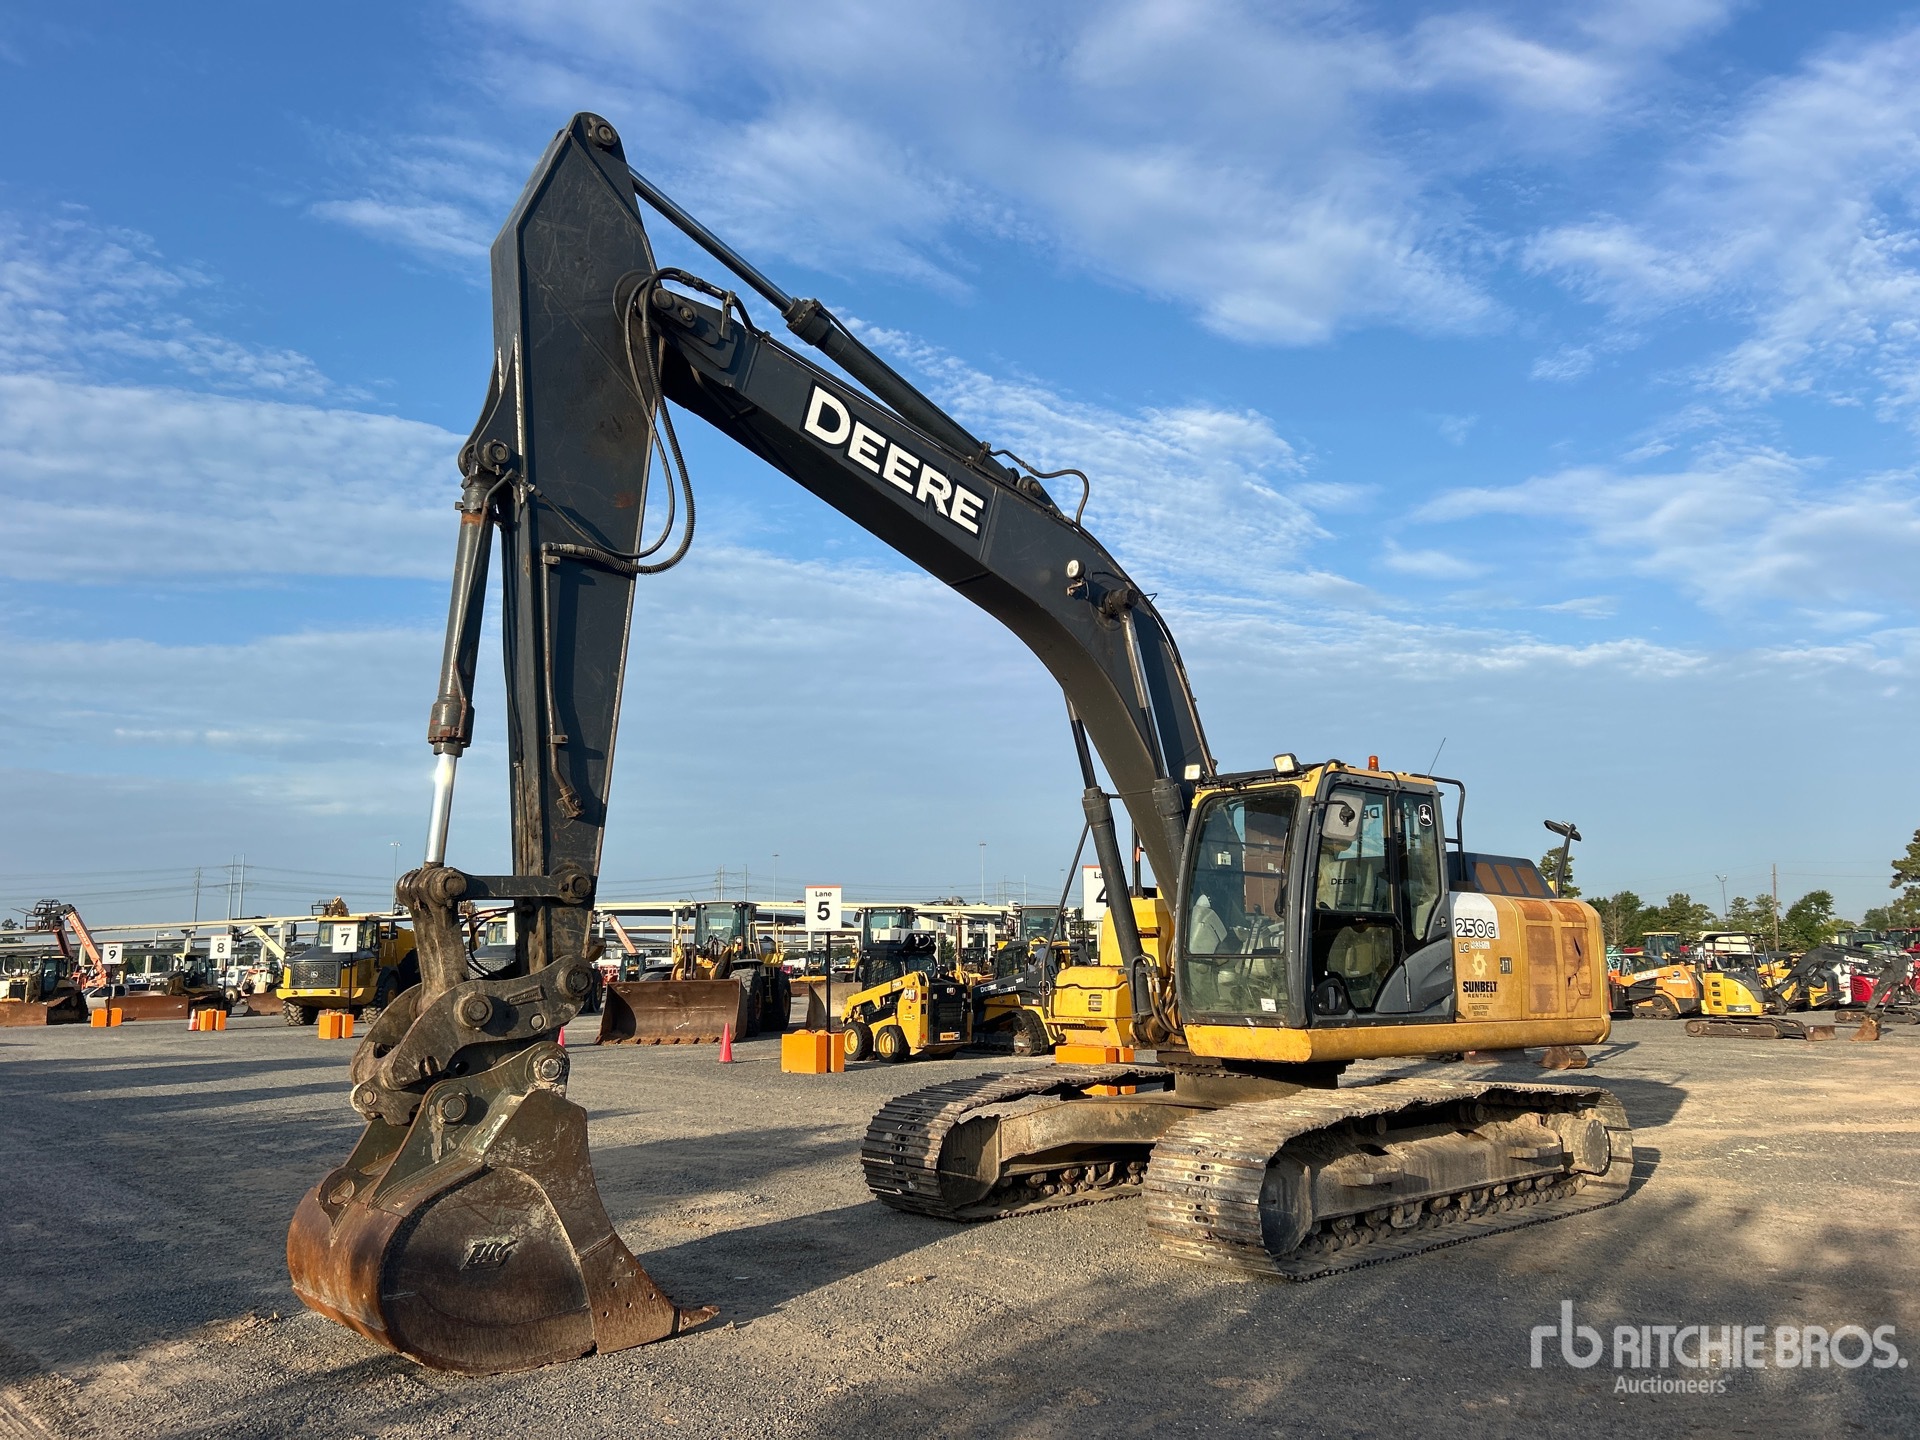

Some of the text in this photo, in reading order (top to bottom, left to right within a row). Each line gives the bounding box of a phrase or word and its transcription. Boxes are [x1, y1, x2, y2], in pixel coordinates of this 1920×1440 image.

[804, 385, 985, 535] DEERE
[1330, 877, 1357, 885] DEER
[1096, 886, 1109, 907] 4
[816, 901, 830, 921] 5
[1455, 918, 1496, 938] 250G
[260, 934, 270, 943] JLG
[341, 934, 350, 946] 7
[217, 943, 225, 953] 8
[1458, 942, 1469, 953] LC
[108, 950, 117, 960] 9
[1844, 955, 1869, 965] DEERE
[1634, 969, 1659, 981] CASE
[1462, 981, 1498, 992] SUNBELT
[904, 988, 915, 1000] CAT
